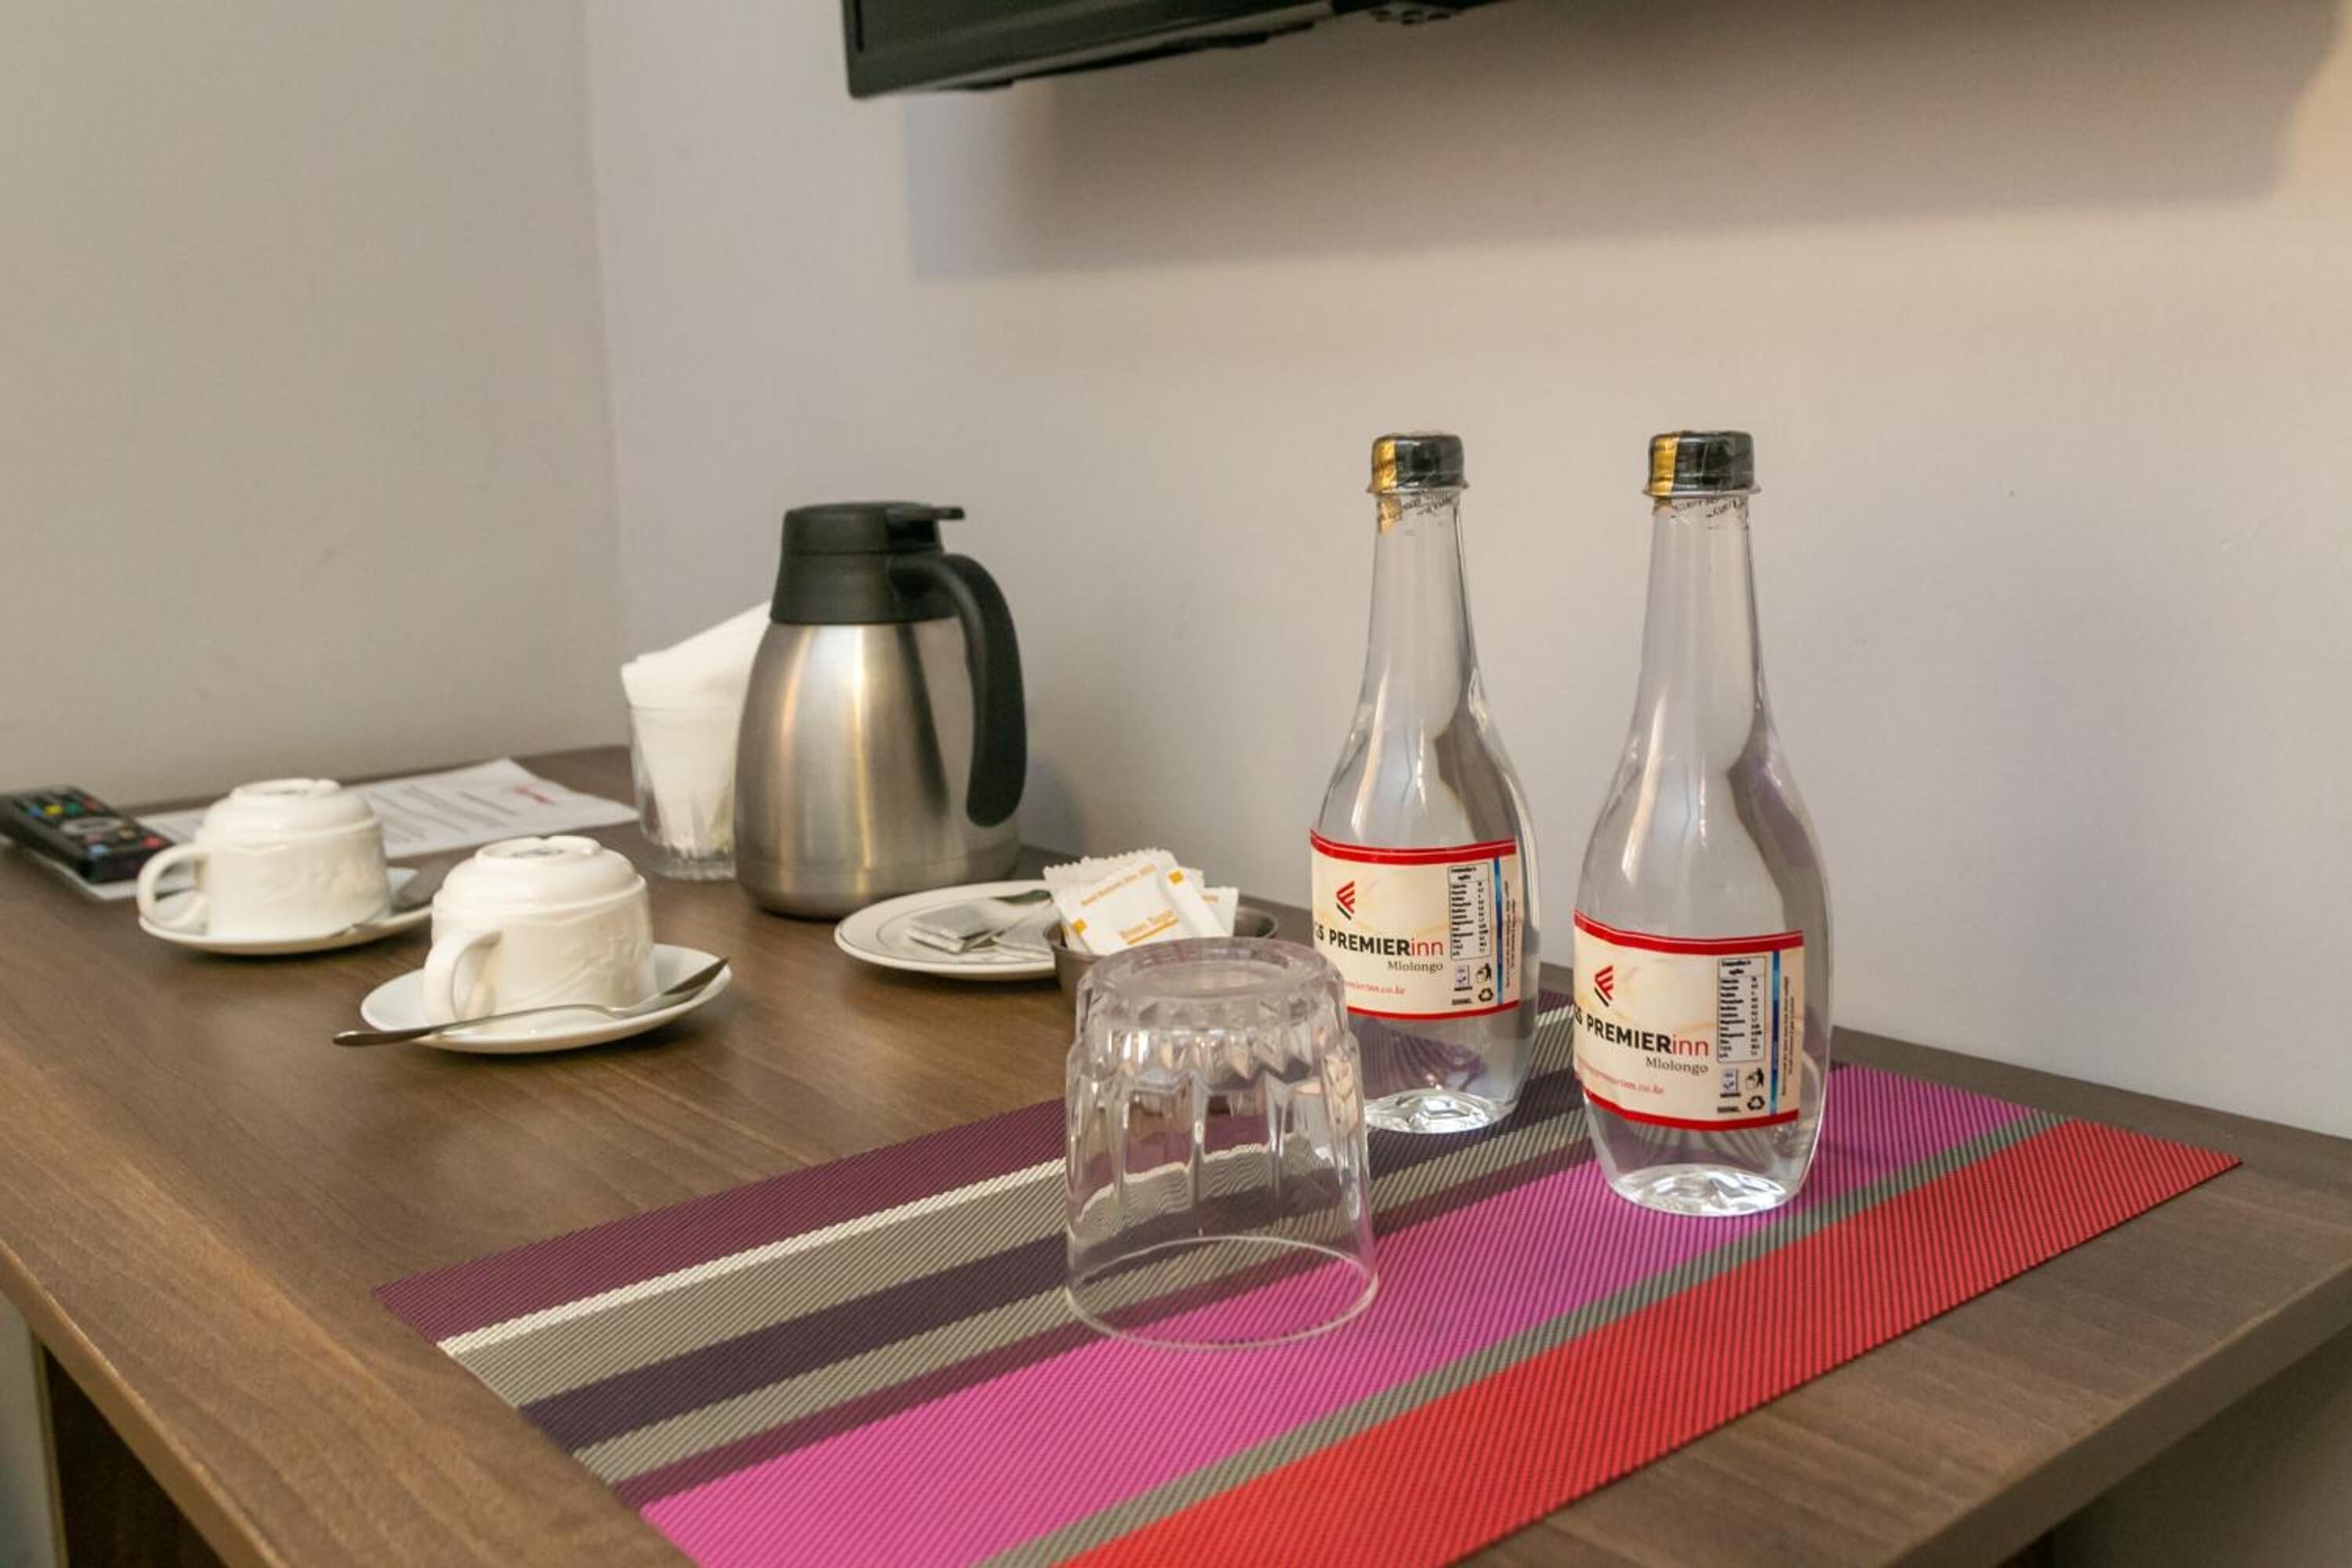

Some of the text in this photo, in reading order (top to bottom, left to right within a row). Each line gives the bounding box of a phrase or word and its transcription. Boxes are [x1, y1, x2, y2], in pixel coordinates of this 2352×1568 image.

[1329, 928, 1444, 956] PREMIERinn
[1387, 960, 1443, 975] Mlolongo
[1586, 1013, 1709, 1057] PREMIERinn
[1646, 1057, 1708, 1076] Mlolongo
